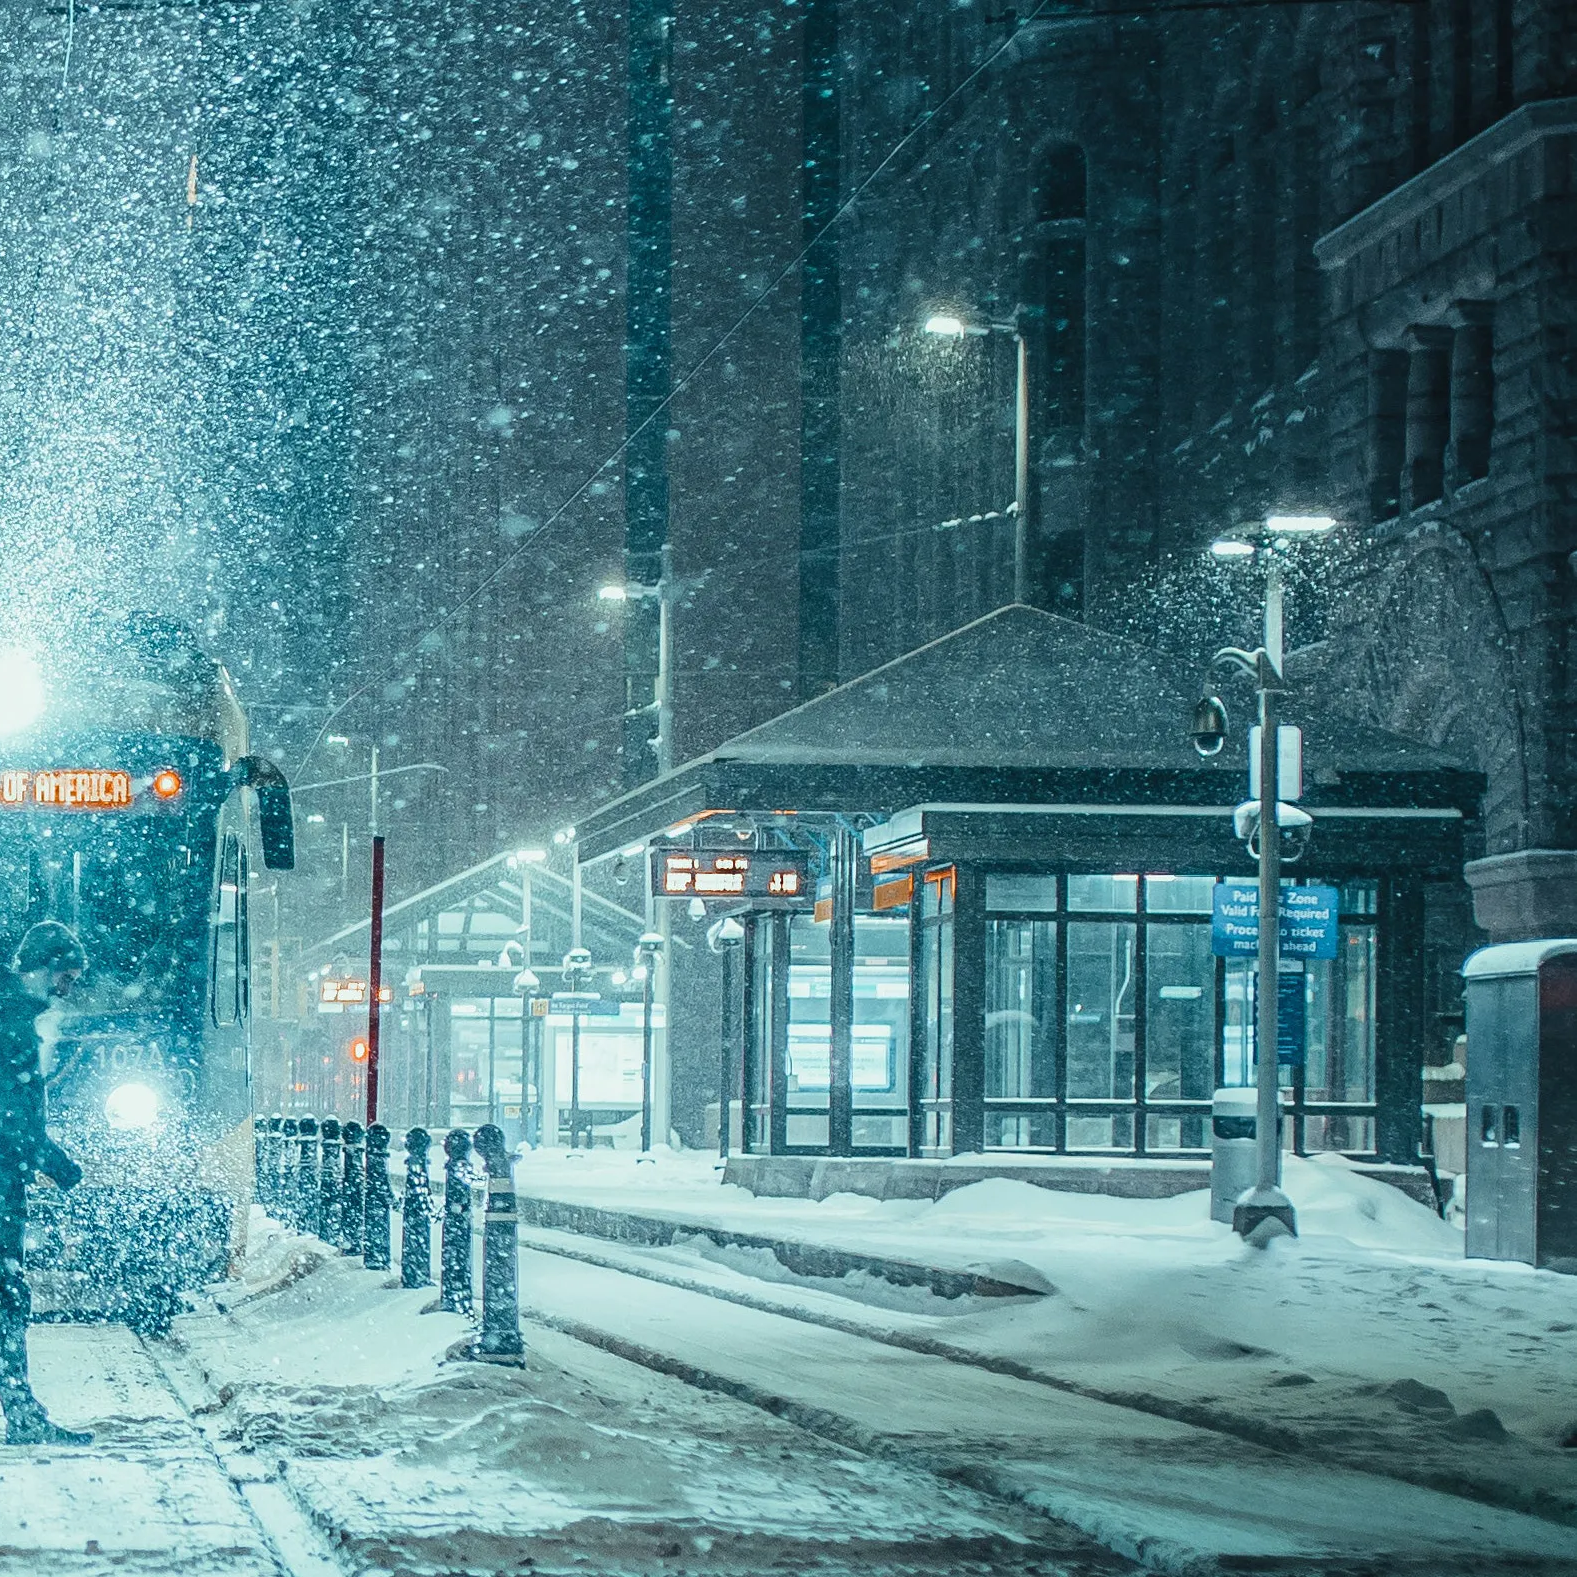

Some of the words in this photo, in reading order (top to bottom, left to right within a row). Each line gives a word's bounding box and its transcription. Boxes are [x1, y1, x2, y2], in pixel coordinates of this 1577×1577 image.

[3, 774, 29, 801] OF
[35, 774, 129, 803] AMERICA
[1233, 891, 1257, 902] Paid
[1287, 892, 1318, 905] Zone
[1221, 905, 1248, 917] Valid
[1279, 906, 1330, 921] Required
[1226, 923, 1259, 936] Proce
[1291, 926, 1325, 938] ticket
[1283, 941, 1316, 952] ahead
